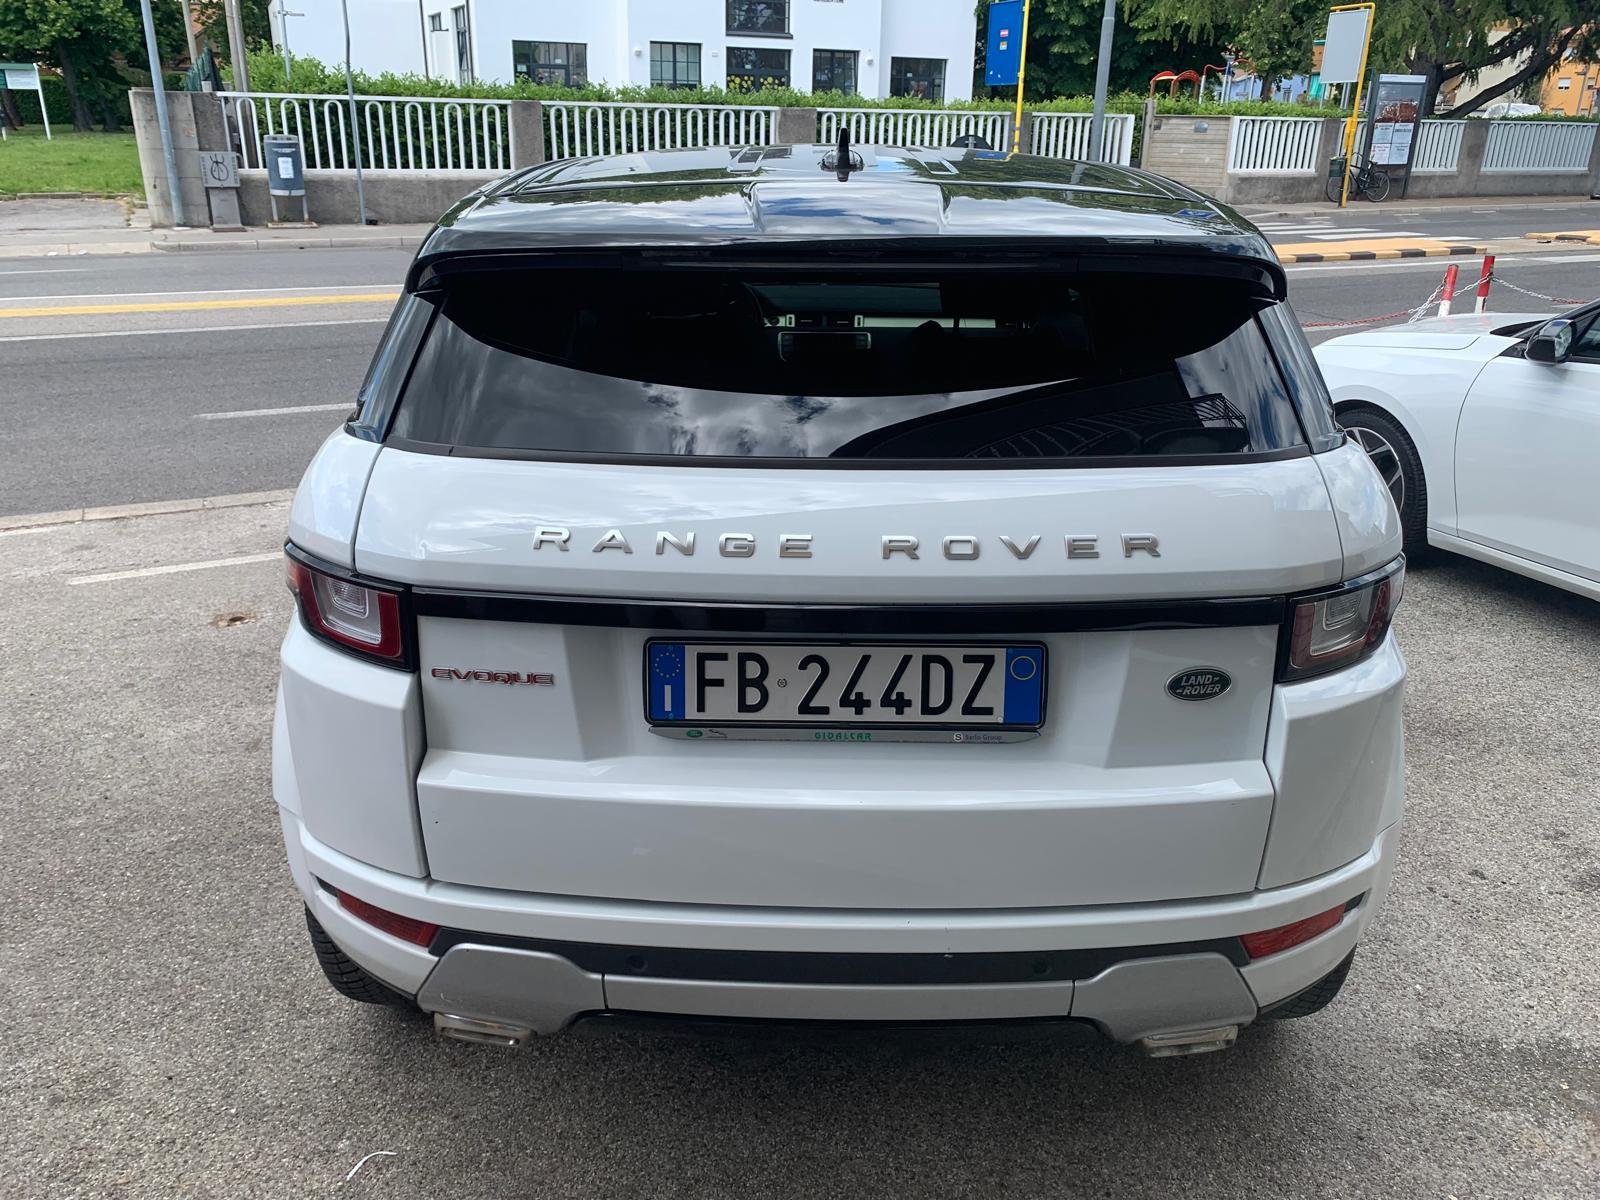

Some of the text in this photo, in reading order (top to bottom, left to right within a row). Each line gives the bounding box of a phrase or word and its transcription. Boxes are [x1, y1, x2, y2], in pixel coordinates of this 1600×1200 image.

[533, 526, 1162, 560] RANGE ROVER
[431, 667, 554, 686] EVOQUE
[696, 652, 995, 716] FB 244DZ
[1182, 684, 1220, 694] ROVER
